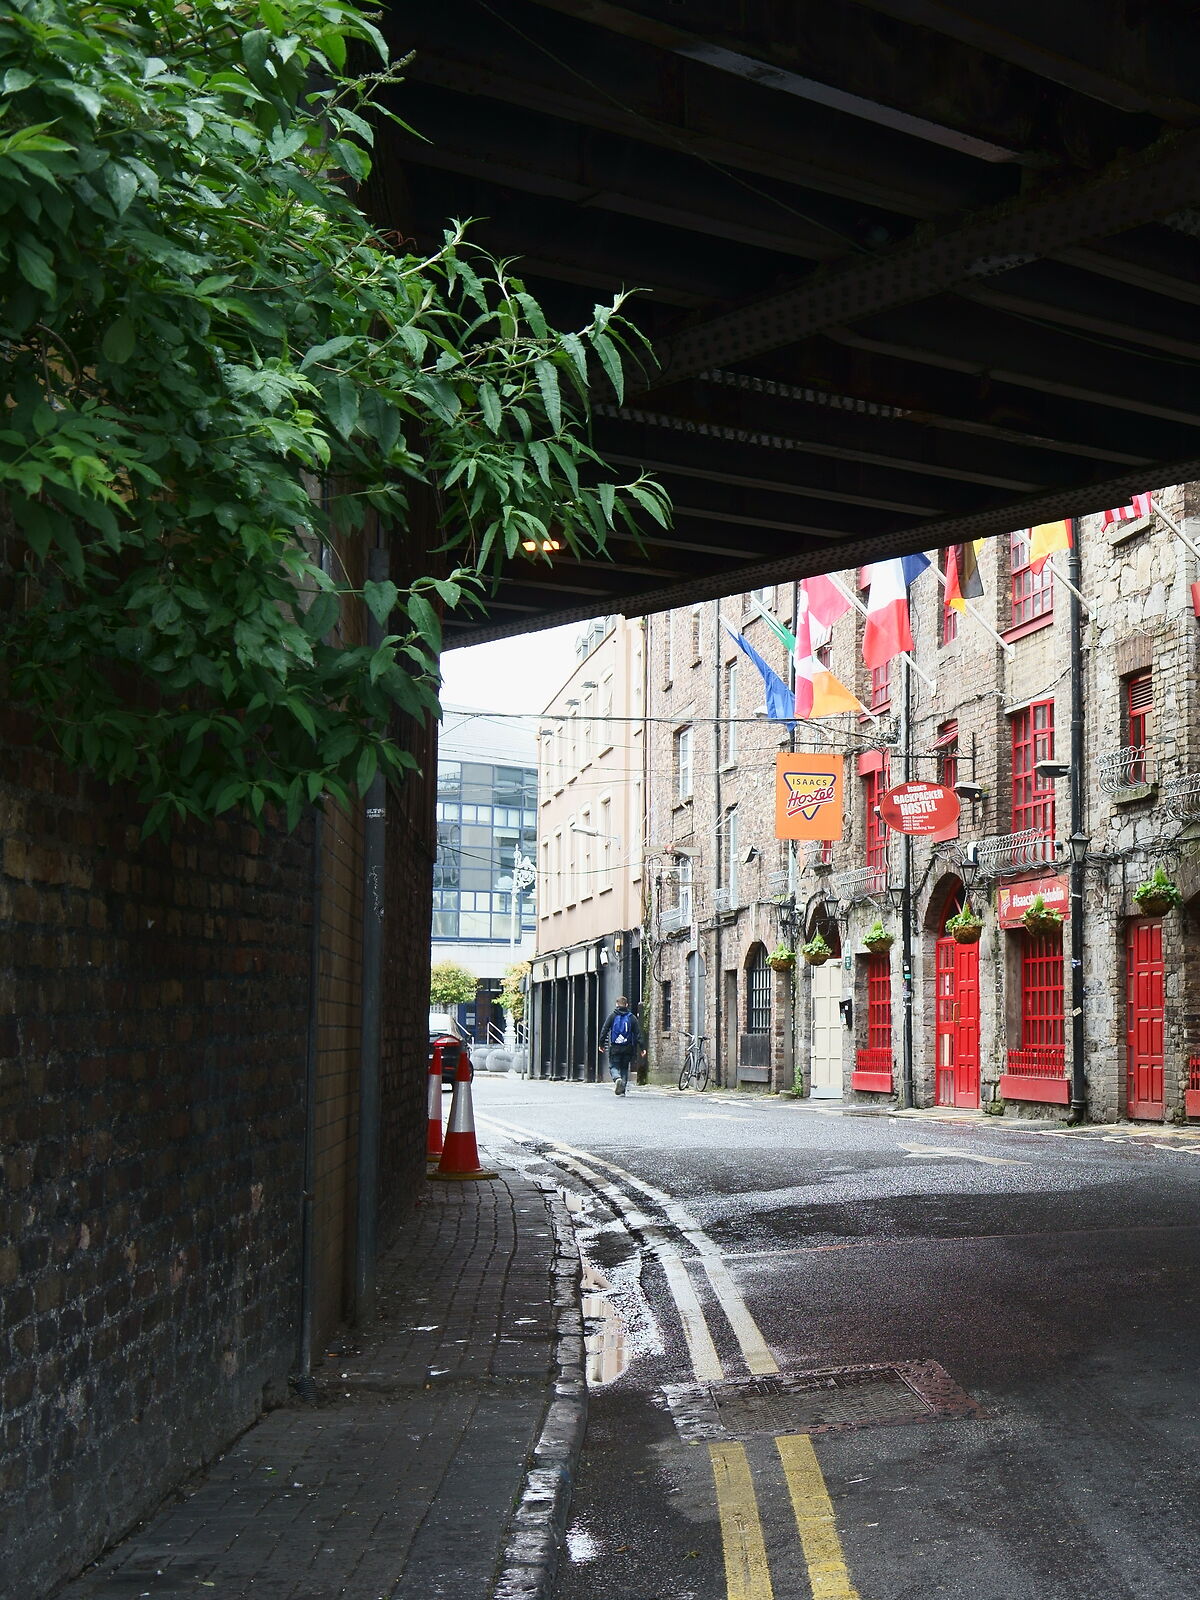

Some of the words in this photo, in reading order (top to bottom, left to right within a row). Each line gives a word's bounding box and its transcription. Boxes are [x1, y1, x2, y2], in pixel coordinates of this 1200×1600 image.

[792, 778, 827, 786] ISAACS
[787, 786, 834, 809] Hostel
[893, 789, 943, 804] BACKPACKER
[900, 800, 937, 815] HOSTEL
